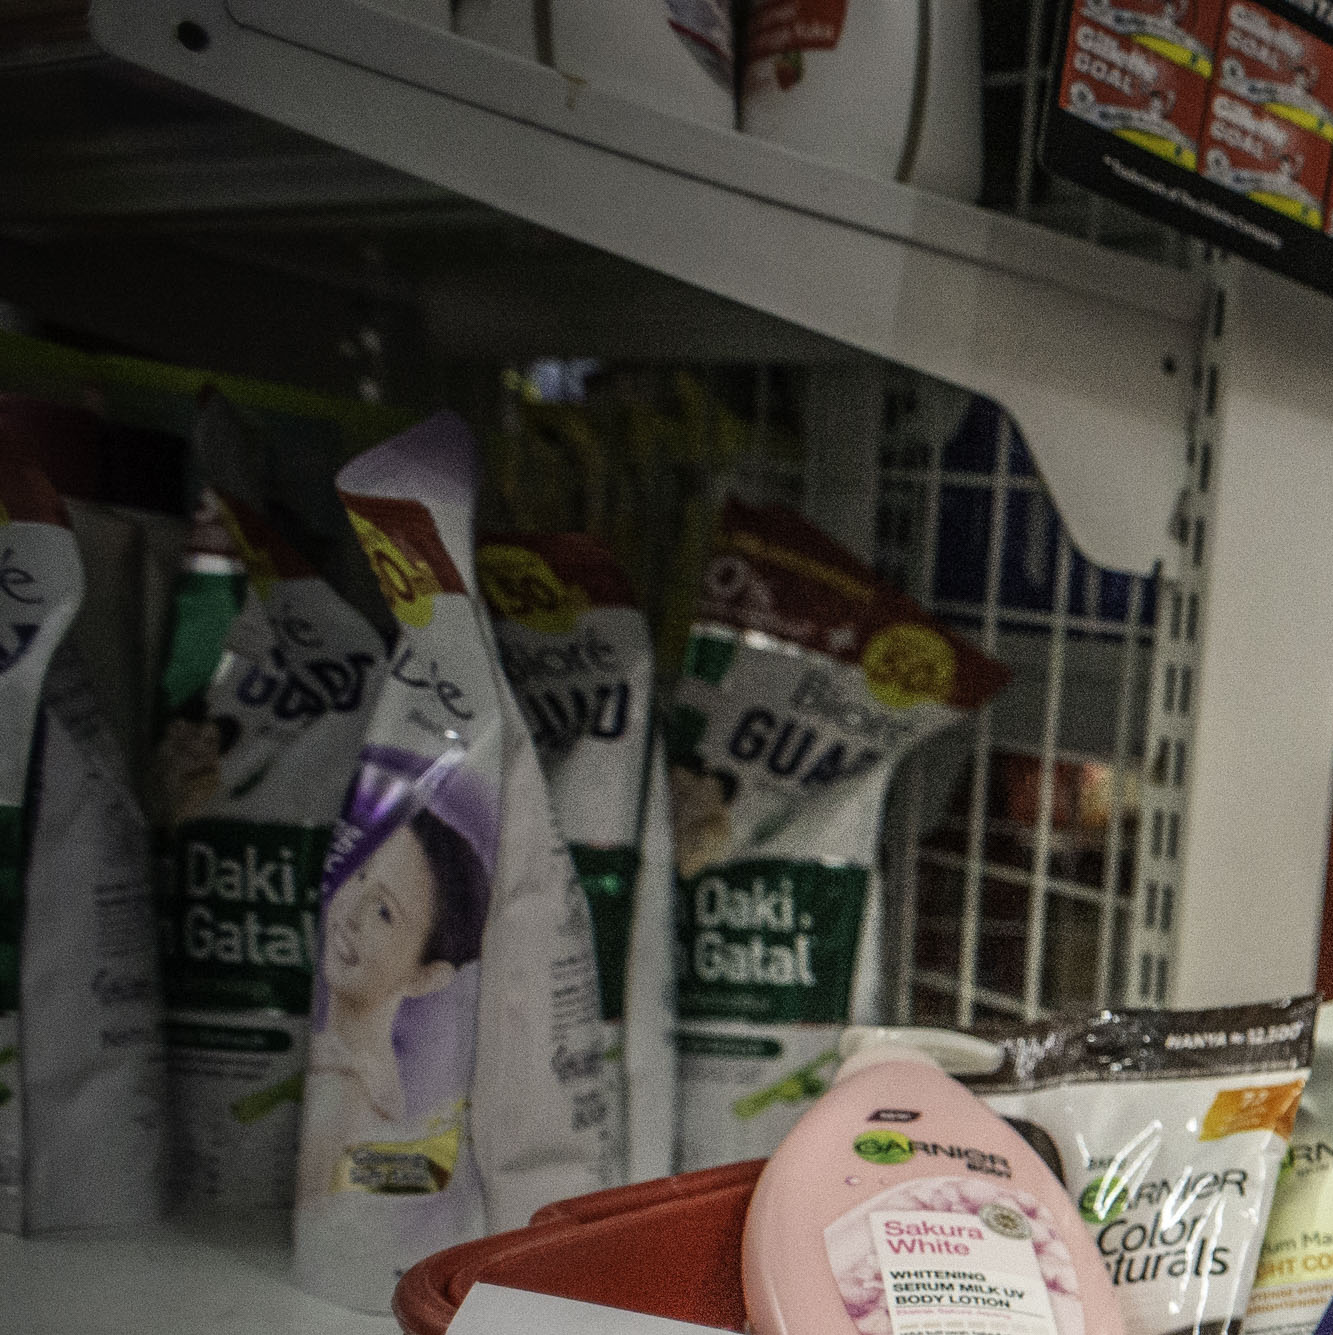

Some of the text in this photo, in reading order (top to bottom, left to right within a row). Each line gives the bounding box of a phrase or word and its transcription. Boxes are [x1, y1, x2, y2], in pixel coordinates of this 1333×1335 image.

[694, 932, 817, 986] Gatal
[854, 1138, 1011, 1169] GARNIER
[884, 1220, 985, 1241] Sakura
[1097, 1212, 1201, 1256] Color
[887, 1238, 971, 1257] White
[1105, 1237, 1231, 1286] turals
[890, 1270, 986, 1282] WHITENING
[893, 1282, 1025, 1299] SERUM MILK UV
[895, 1294, 1011, 1308] BODY LOTION
